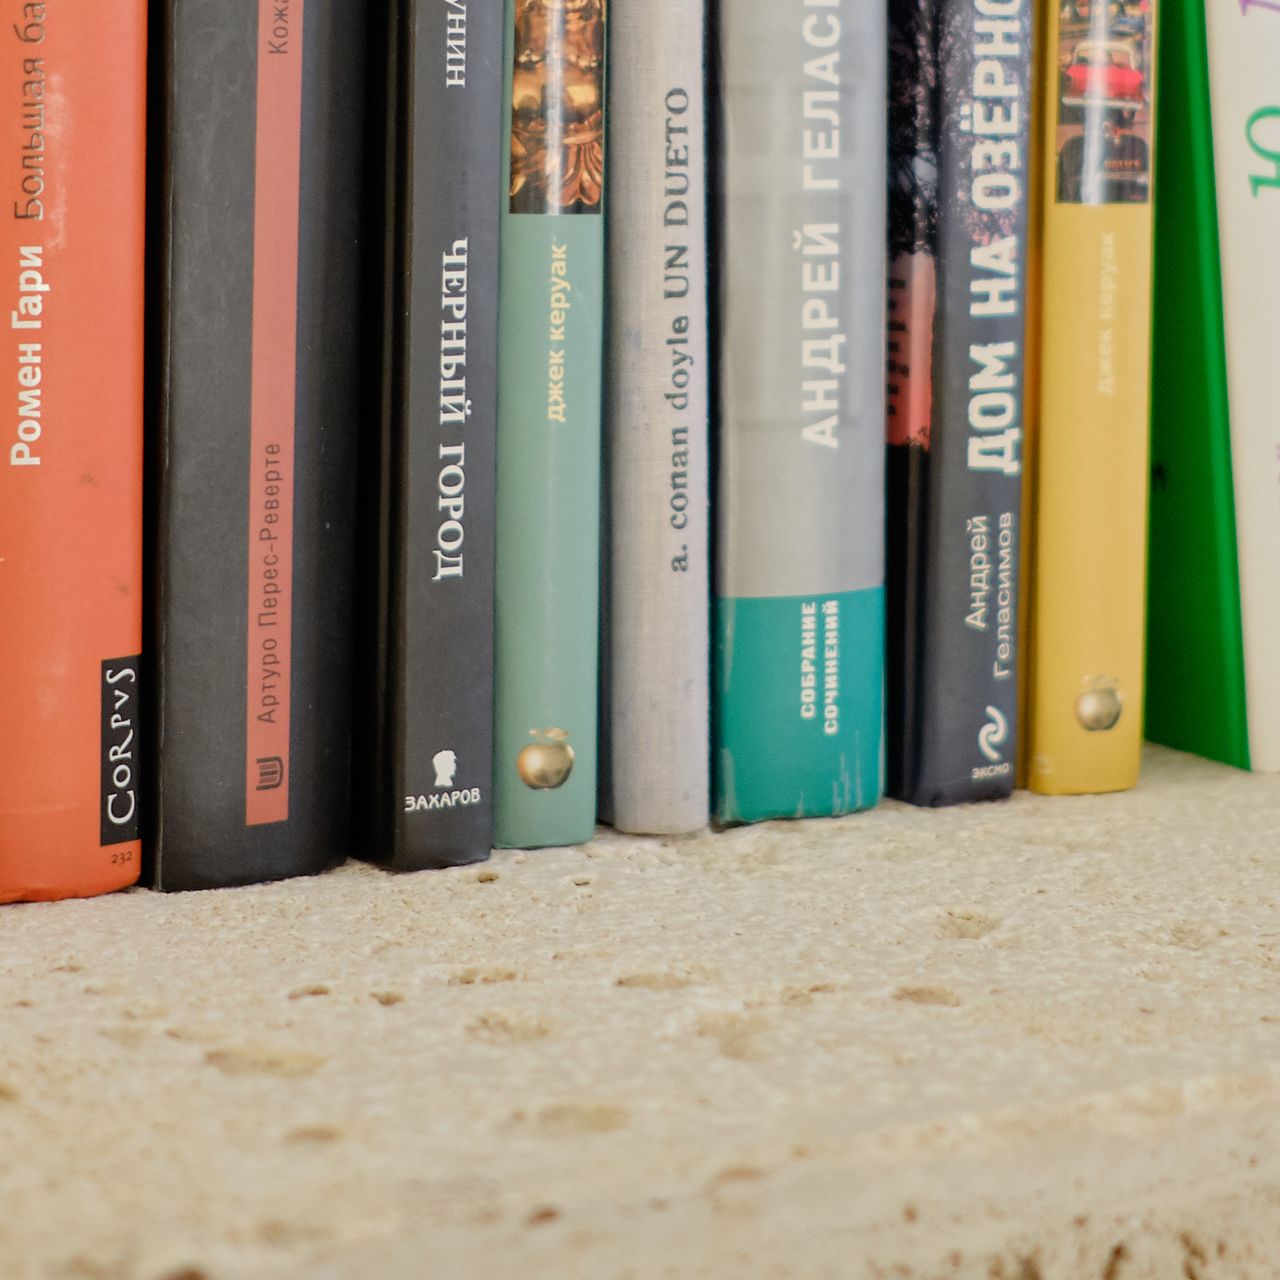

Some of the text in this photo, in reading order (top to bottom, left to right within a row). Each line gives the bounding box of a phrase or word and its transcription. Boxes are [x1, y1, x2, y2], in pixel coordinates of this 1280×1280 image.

[14, 57, 45, 221] Большая
[11, 245, 48, 329] Гари
[547, 244, 571, 423] джек керуак
[663, 86, 694, 573] a. conan doyle UN DUETO
[792, 222, 847, 450] АНДРЕЙ
[969, 234, 1017, 317] НА
[11, 343, 42, 467] Ромен
[432, 237, 474, 580] ЧЕРНЫЙ ГОРОД
[967, 340, 1021, 477] ДОМ
[257, 442, 284, 724] Артуро Перес-Реверте
[964, 514, 989, 631] Андрей
[993, 512, 1013, 680] Геласимов
[800, 601, 817, 720] СОБРАНИЕ
[821, 600, 840, 735] СОЧИНЕНИЙ
[111, 850, 132, 865] 232
[404, 787, 481, 811] ЗАХАРОВ
